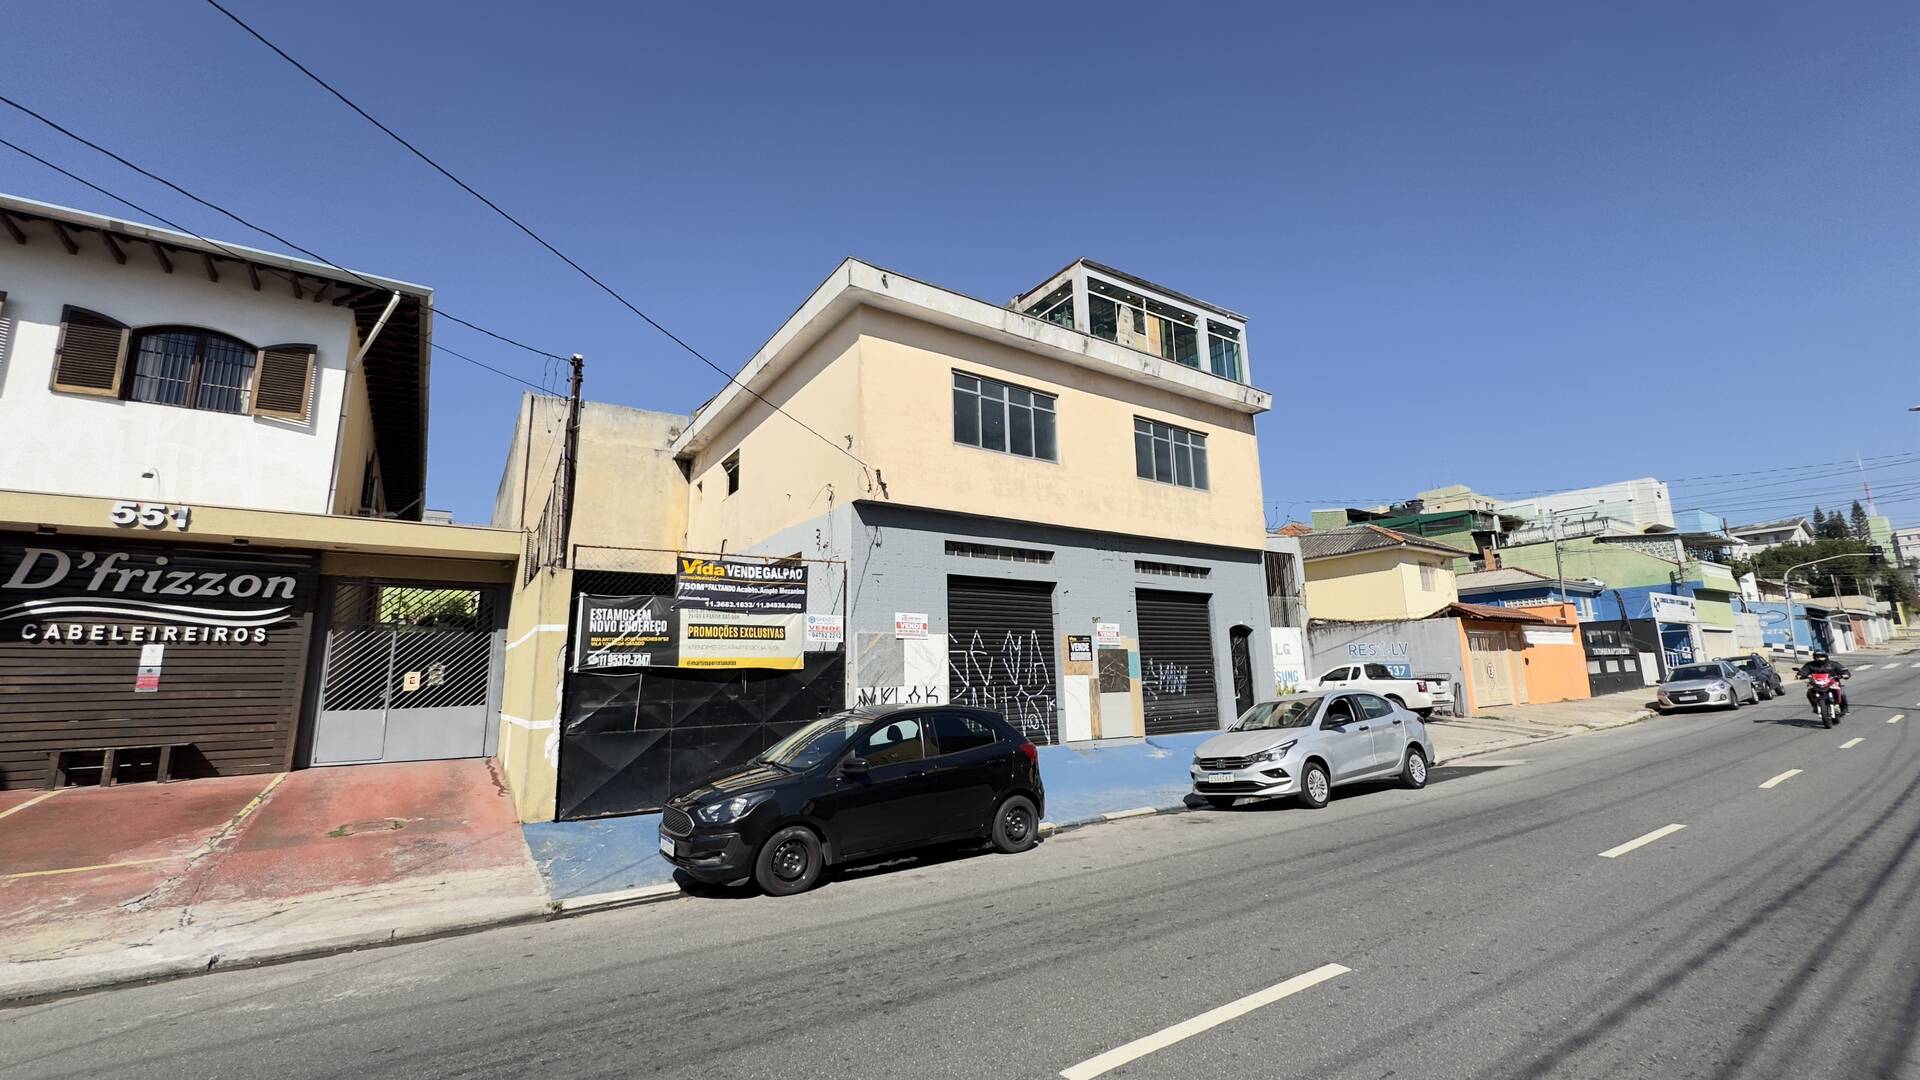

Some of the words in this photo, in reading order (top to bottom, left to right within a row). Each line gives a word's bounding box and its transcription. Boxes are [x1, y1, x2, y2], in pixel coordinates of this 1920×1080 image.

[111, 501, 189, 528] 551
[682, 560, 725, 576] Vida
[726, 565, 762, 578] VENDE
[763, 567, 803, 580] GALPÃO
[590, 608, 635, 621] ESTAMOS
[636, 608, 652, 620] EM
[21, 623, 267, 642] CABELEIREIROS
[589, 620, 617, 632] NOVO
[619, 620, 668, 635] ENDEREÇO
[688, 624, 739, 639] PROMOÇÕES
[740, 627, 785, 639] EXCLUSIVAS
[1070, 642, 1090, 651] VENDE
[1275, 643, 1291, 656] LG
